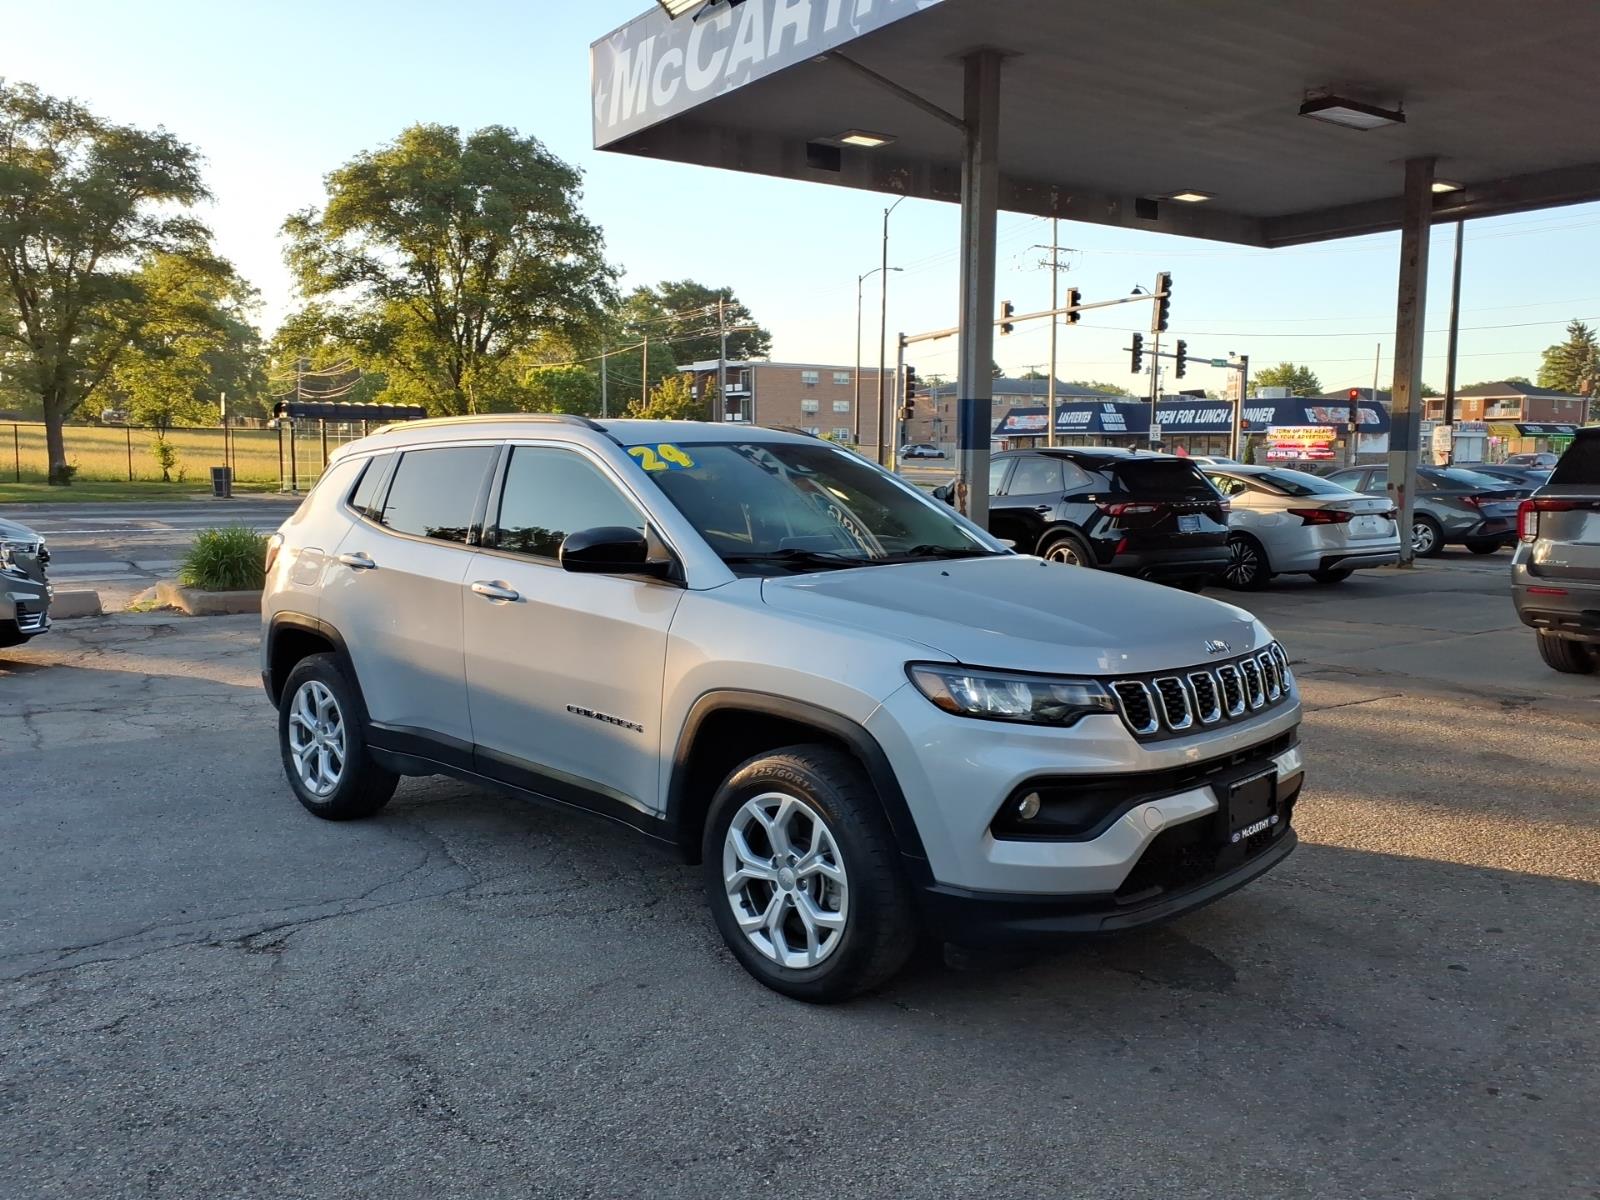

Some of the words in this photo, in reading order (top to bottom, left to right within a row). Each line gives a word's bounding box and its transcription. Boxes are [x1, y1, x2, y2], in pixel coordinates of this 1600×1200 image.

[1175, 410, 1196, 424] FOR
[1195, 409, 1229, 424] LUNCH
[1241, 818, 1270, 839] McCARTHY
